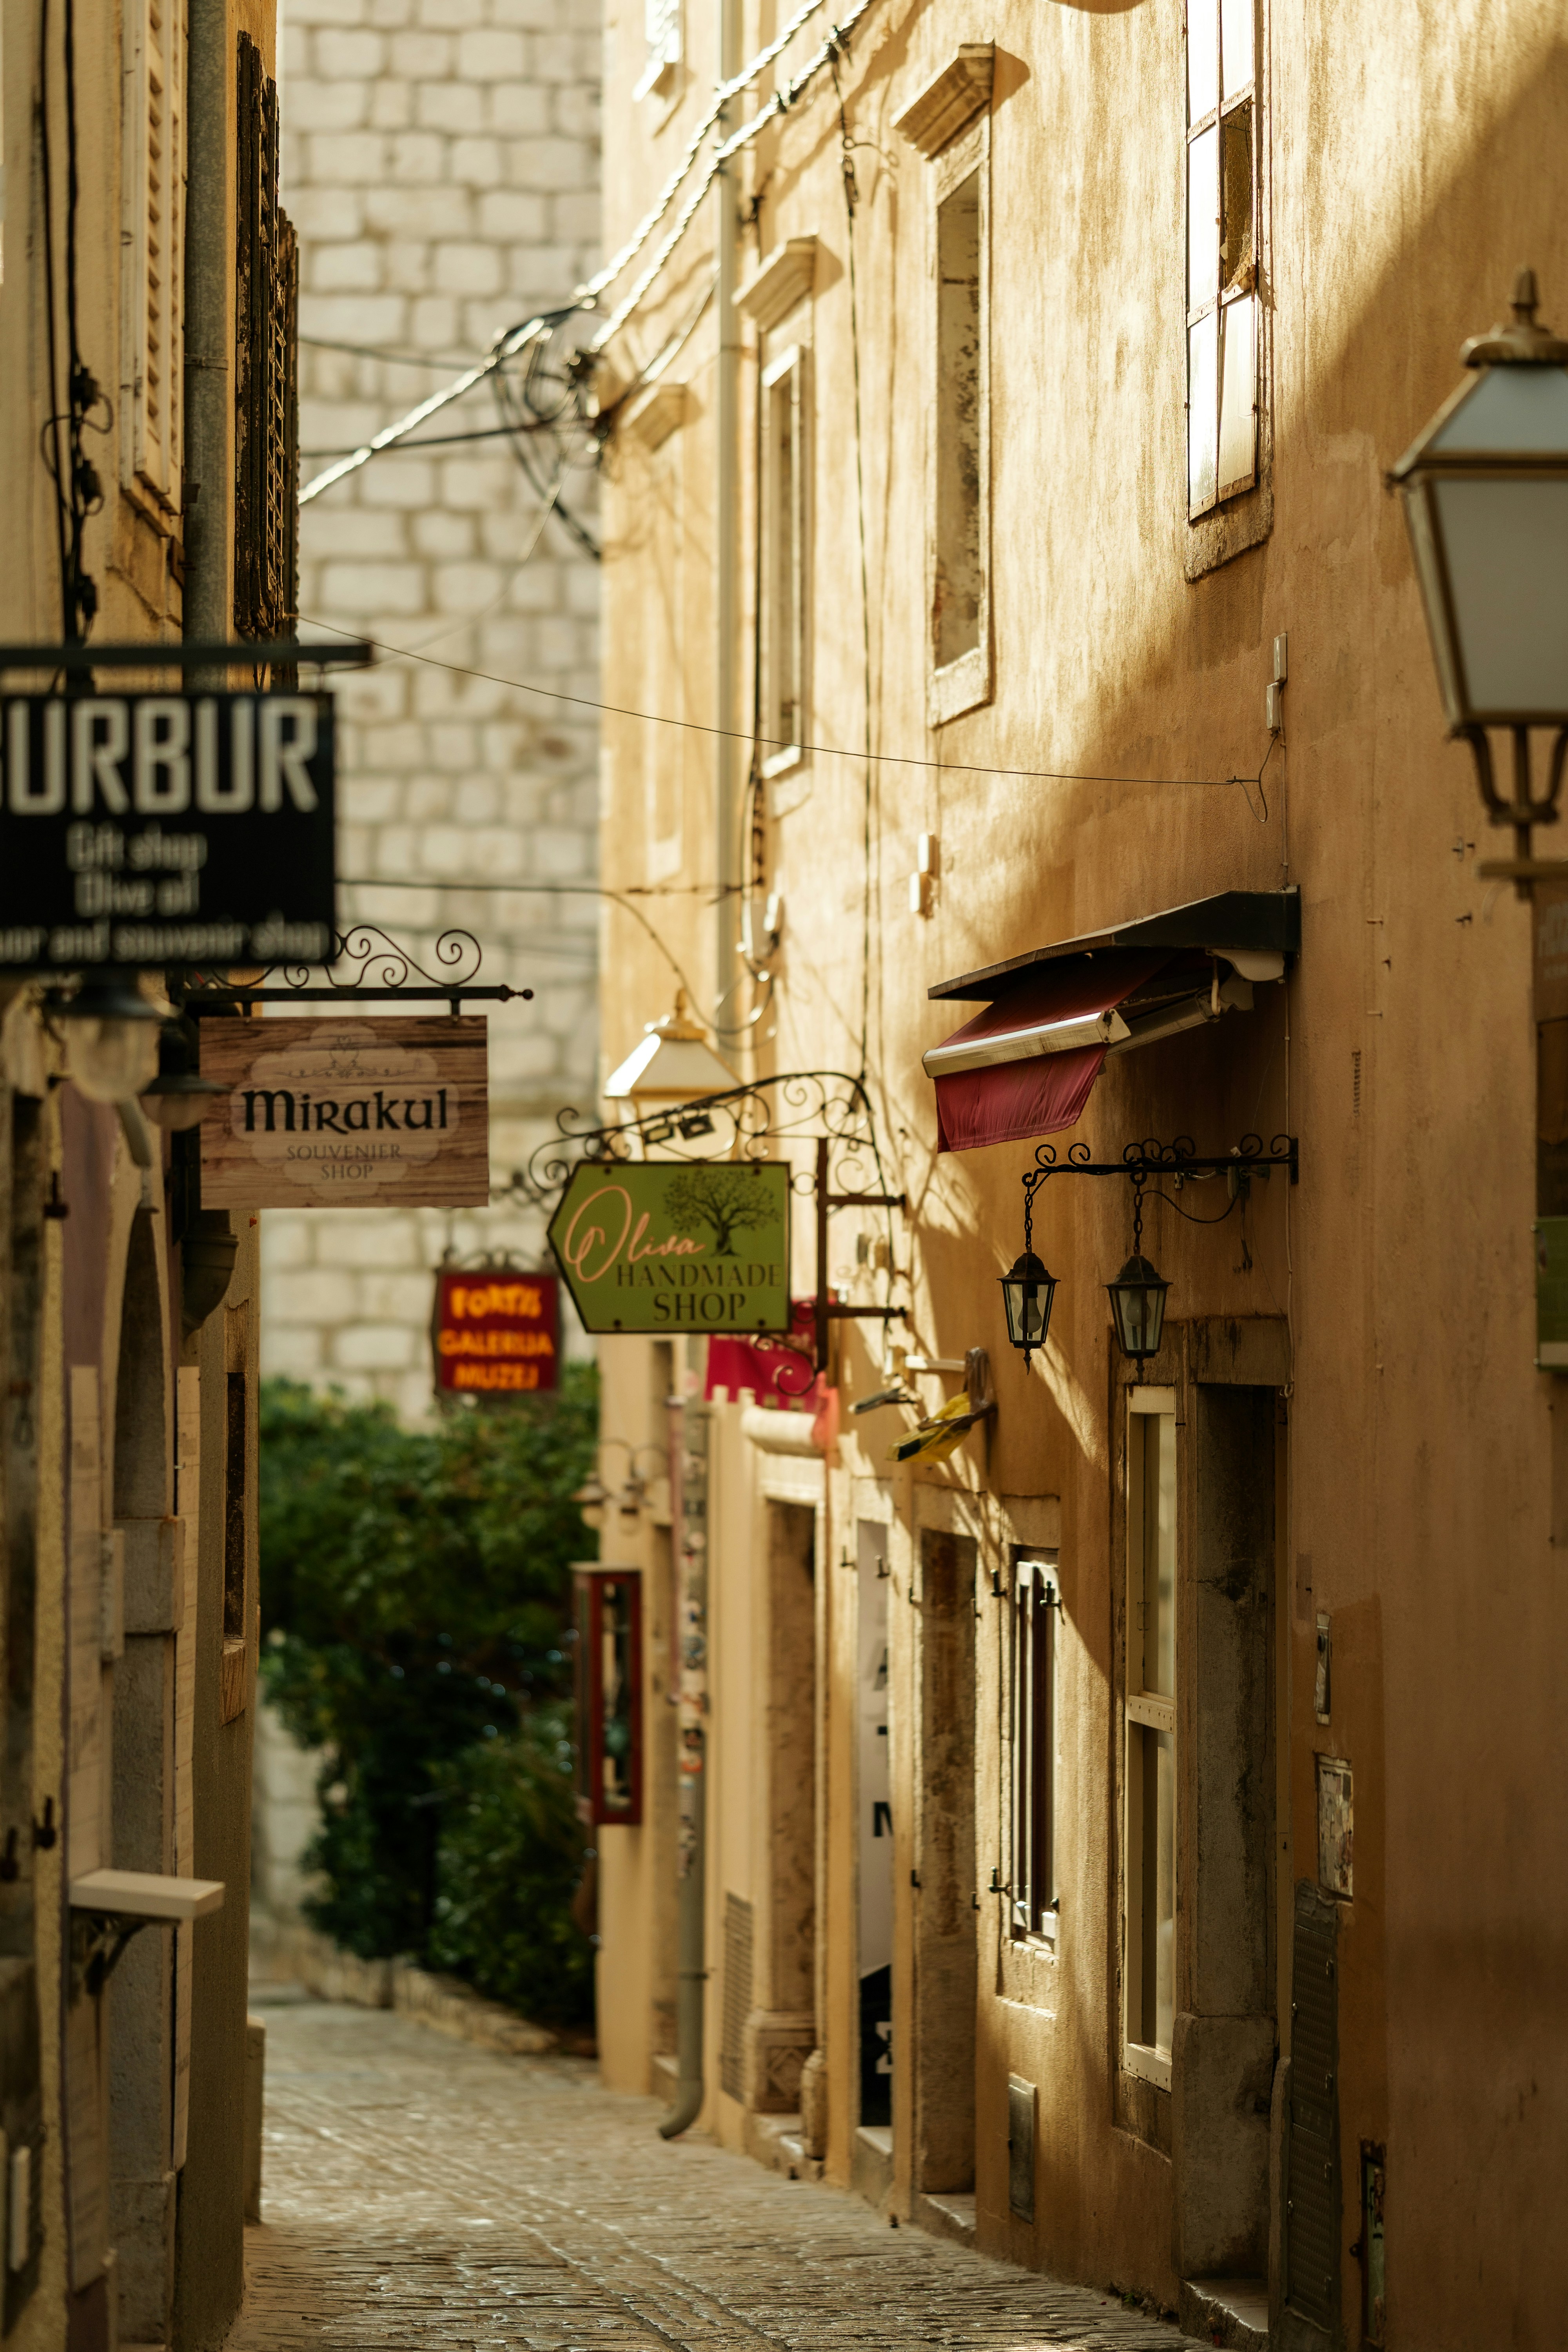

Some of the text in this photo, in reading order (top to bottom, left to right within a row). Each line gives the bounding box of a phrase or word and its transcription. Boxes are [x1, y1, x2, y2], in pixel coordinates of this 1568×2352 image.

[0, 698, 318, 815] URBUR
[241, 1089, 447, 1134] Mirakul
[287, 1143, 401, 1161] SOUVENIER
[321, 1164, 373, 1180] SHOP
[564, 1185, 706, 1282] Oliva
[616, 1264, 782, 1287] HANDMADE
[653, 1293, 746, 1322] SHOP
